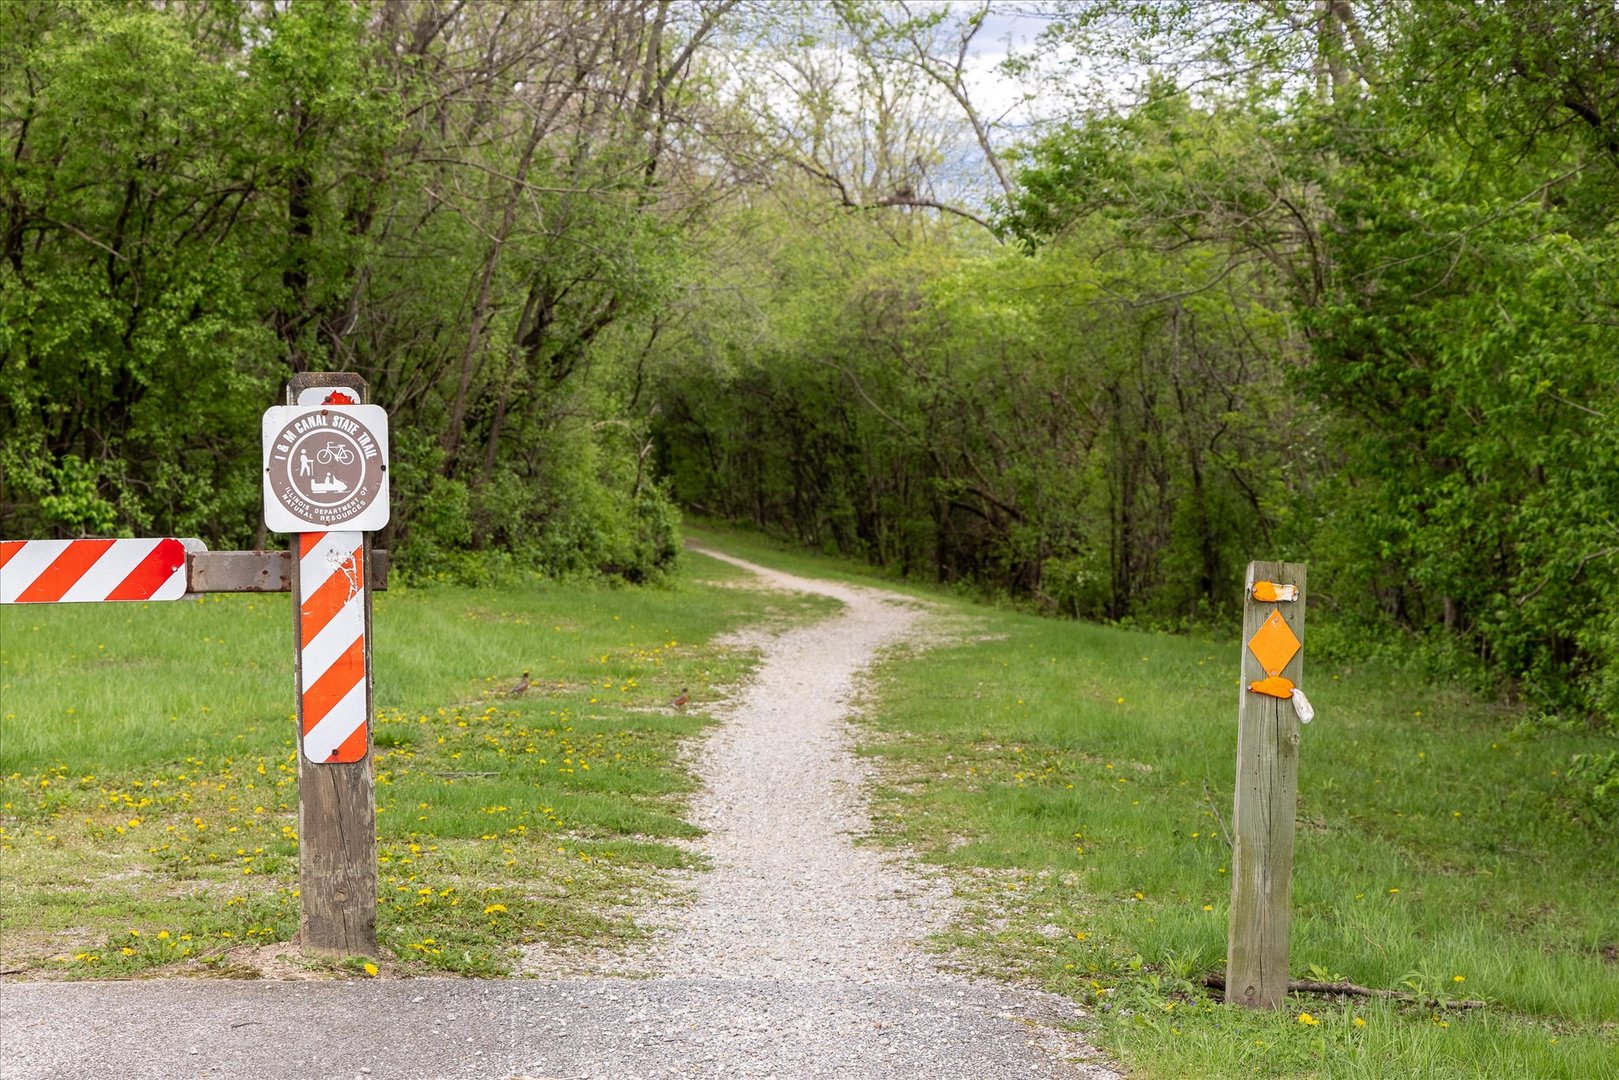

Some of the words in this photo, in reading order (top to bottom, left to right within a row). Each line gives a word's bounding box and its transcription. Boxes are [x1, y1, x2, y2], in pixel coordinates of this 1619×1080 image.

[294, 415, 328, 434] CANAL
[332, 415, 360, 435] STATE
[282, 430, 297, 443] M
[357, 431, 377, 460] TRAIL
[277, 444, 289, 453] &
[281, 494, 314, 519] NATURAL
[319, 500, 366, 521] RESOURCES
[284, 486, 310, 511] ILLINOIS
[314, 497, 360, 515] DEPARTMENT
[360, 486, 369, 496] OF
